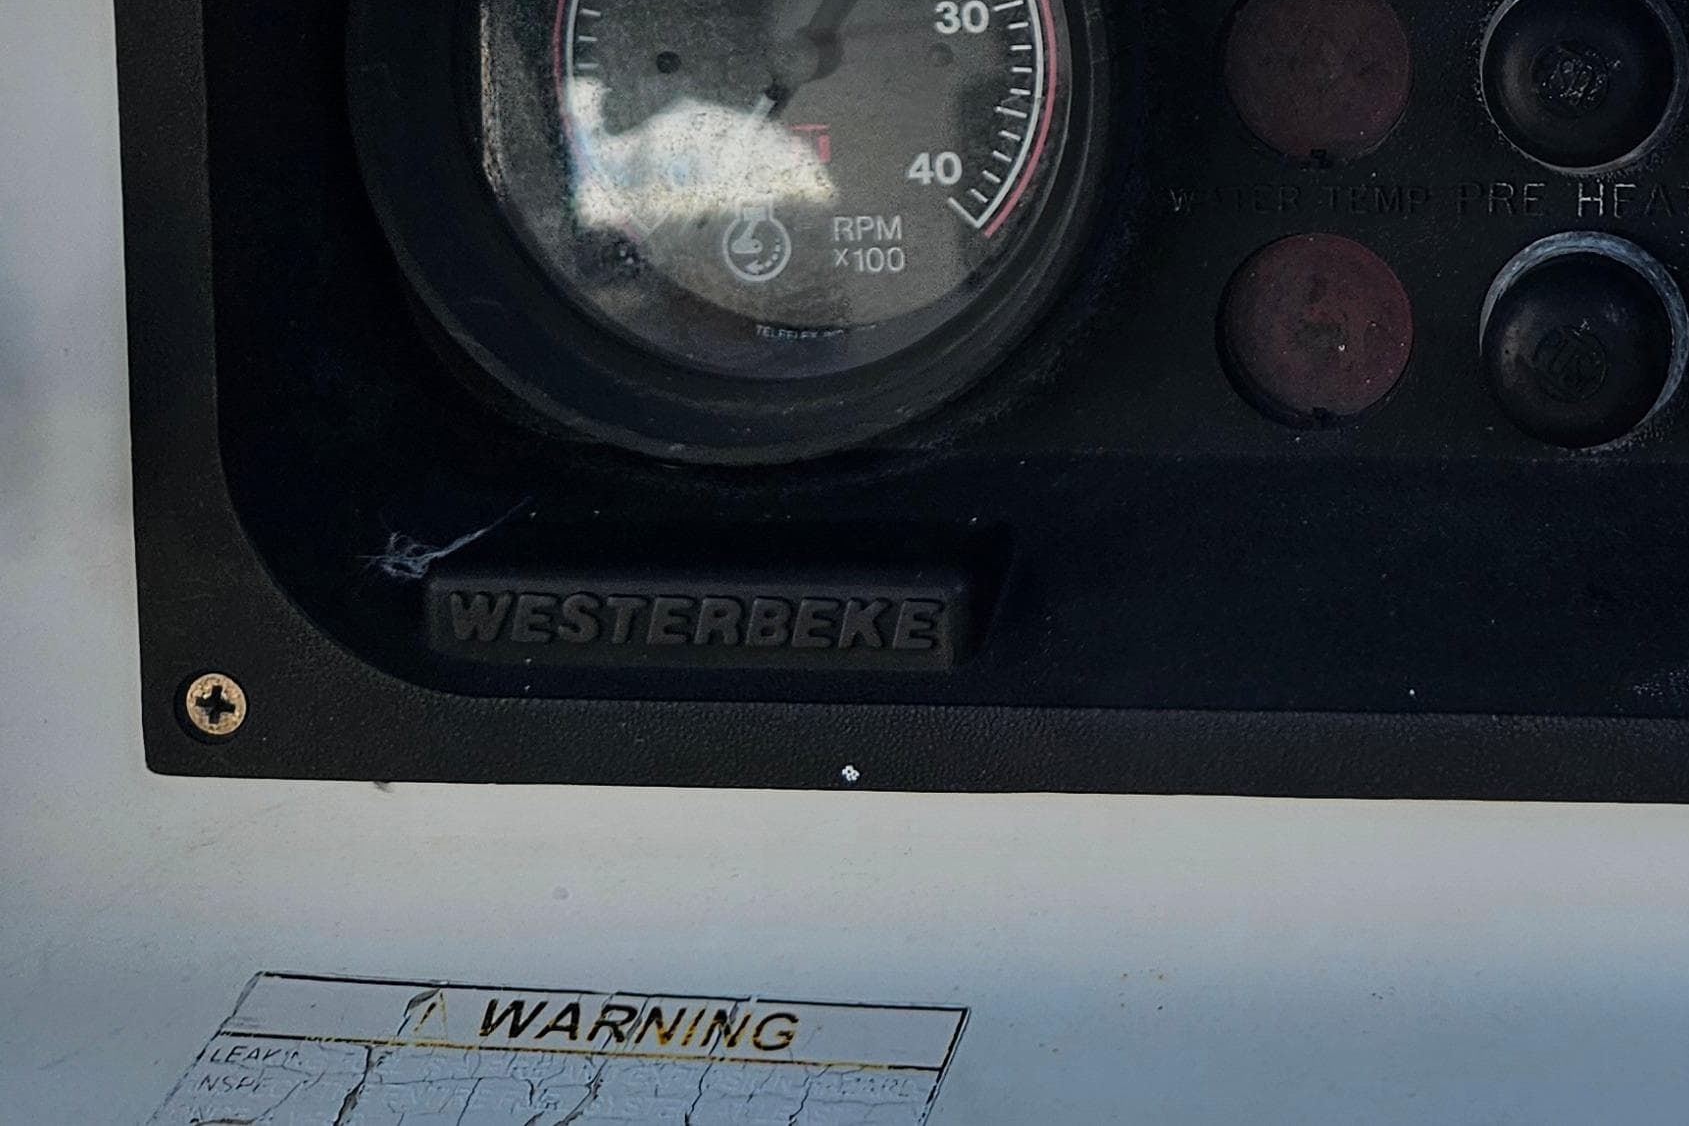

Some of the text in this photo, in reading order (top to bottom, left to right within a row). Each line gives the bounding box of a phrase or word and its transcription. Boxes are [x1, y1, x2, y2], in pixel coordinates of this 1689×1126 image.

[934, 0, 991, 34] 30
[907, 150, 963, 186] 40
[832, 214, 903, 242] RPM
[450, 591, 945, 652] WESTERBEKE
[479, 998, 801, 1052] WARNING
